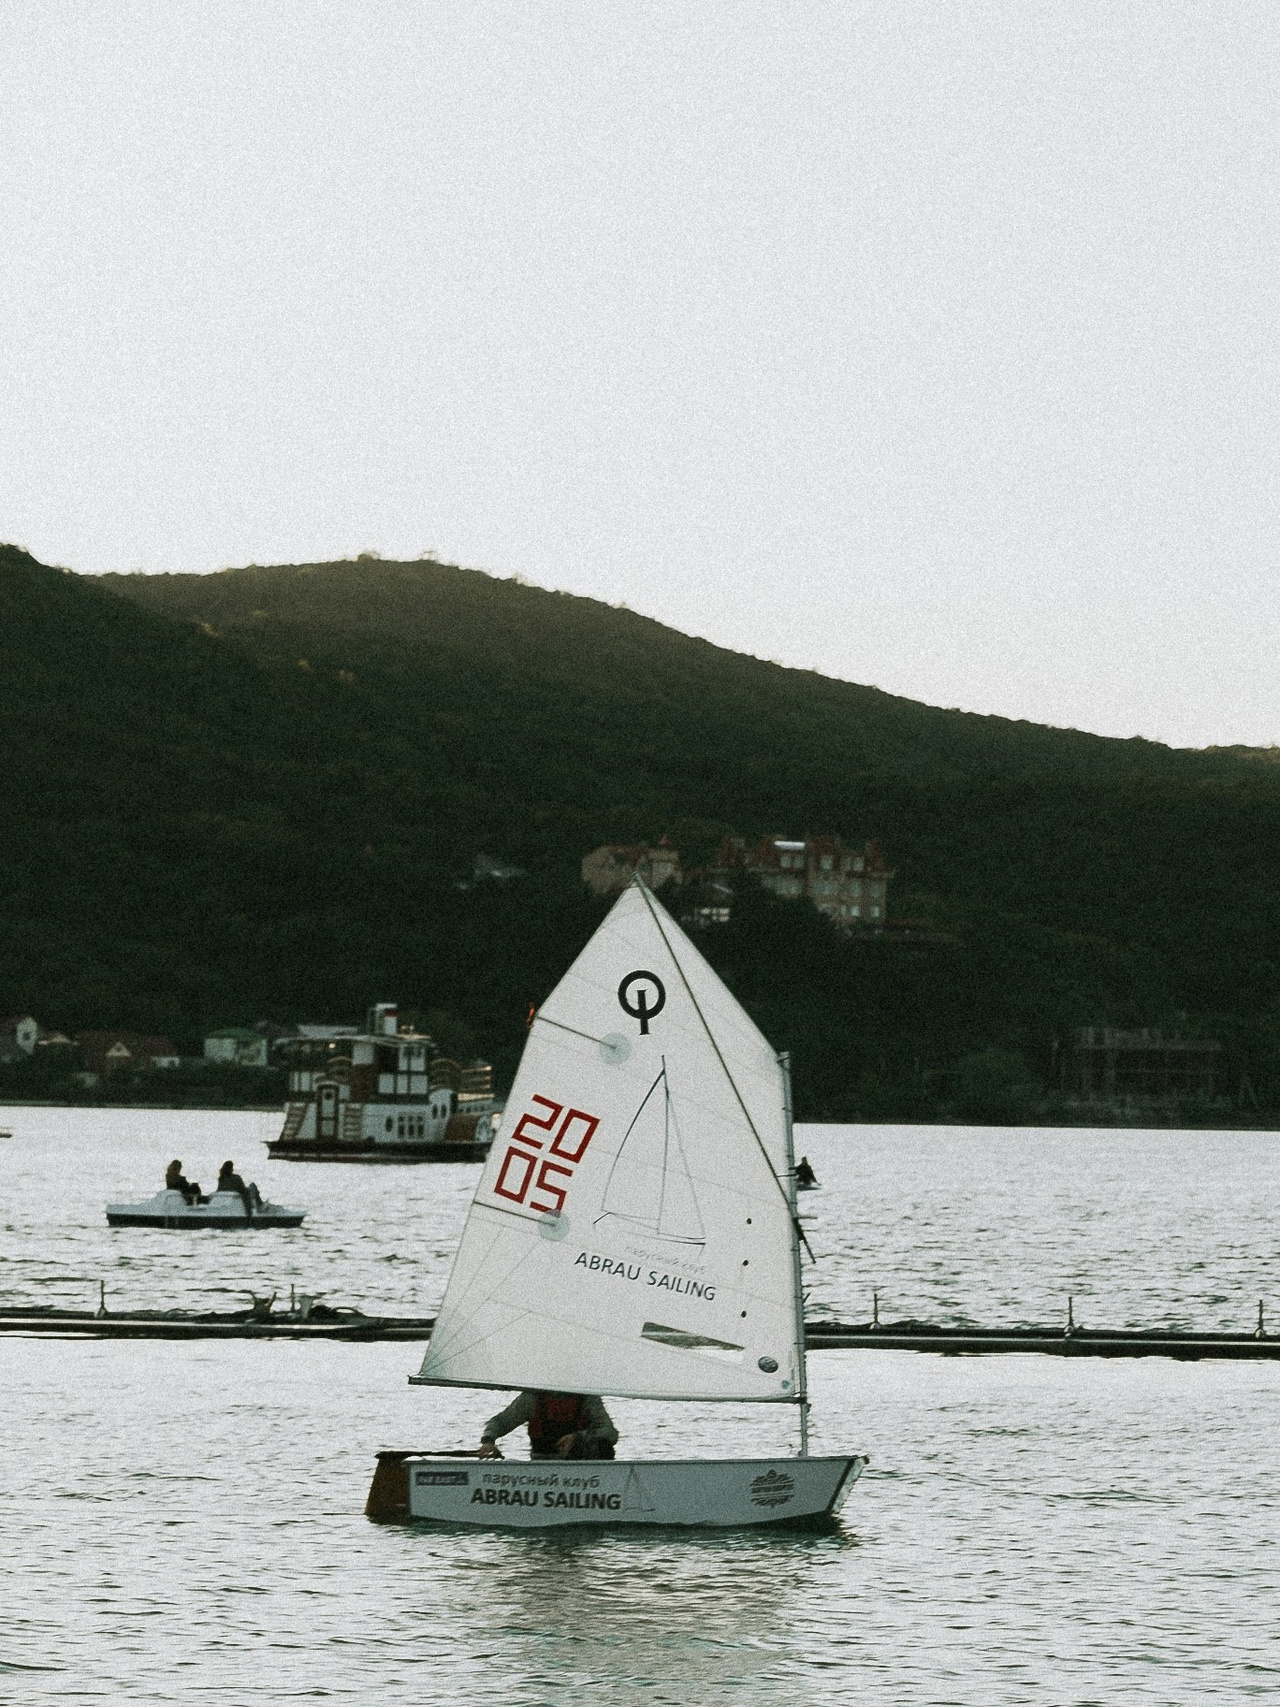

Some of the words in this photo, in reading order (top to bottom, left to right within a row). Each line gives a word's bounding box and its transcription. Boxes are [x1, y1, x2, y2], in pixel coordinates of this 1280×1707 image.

[512, 1094, 600, 1163] 20
[494, 1145, 574, 1218] 05
[575, 1252, 641, 1280] ABRAU
[647, 1270, 716, 1301] SAILING
[470, 1488, 539, 1507] ABRAU
[543, 1491, 621, 1510] SAILING
[482, 1473, 559, 1487] парусный
[562, 1474, 600, 1490] клуб
